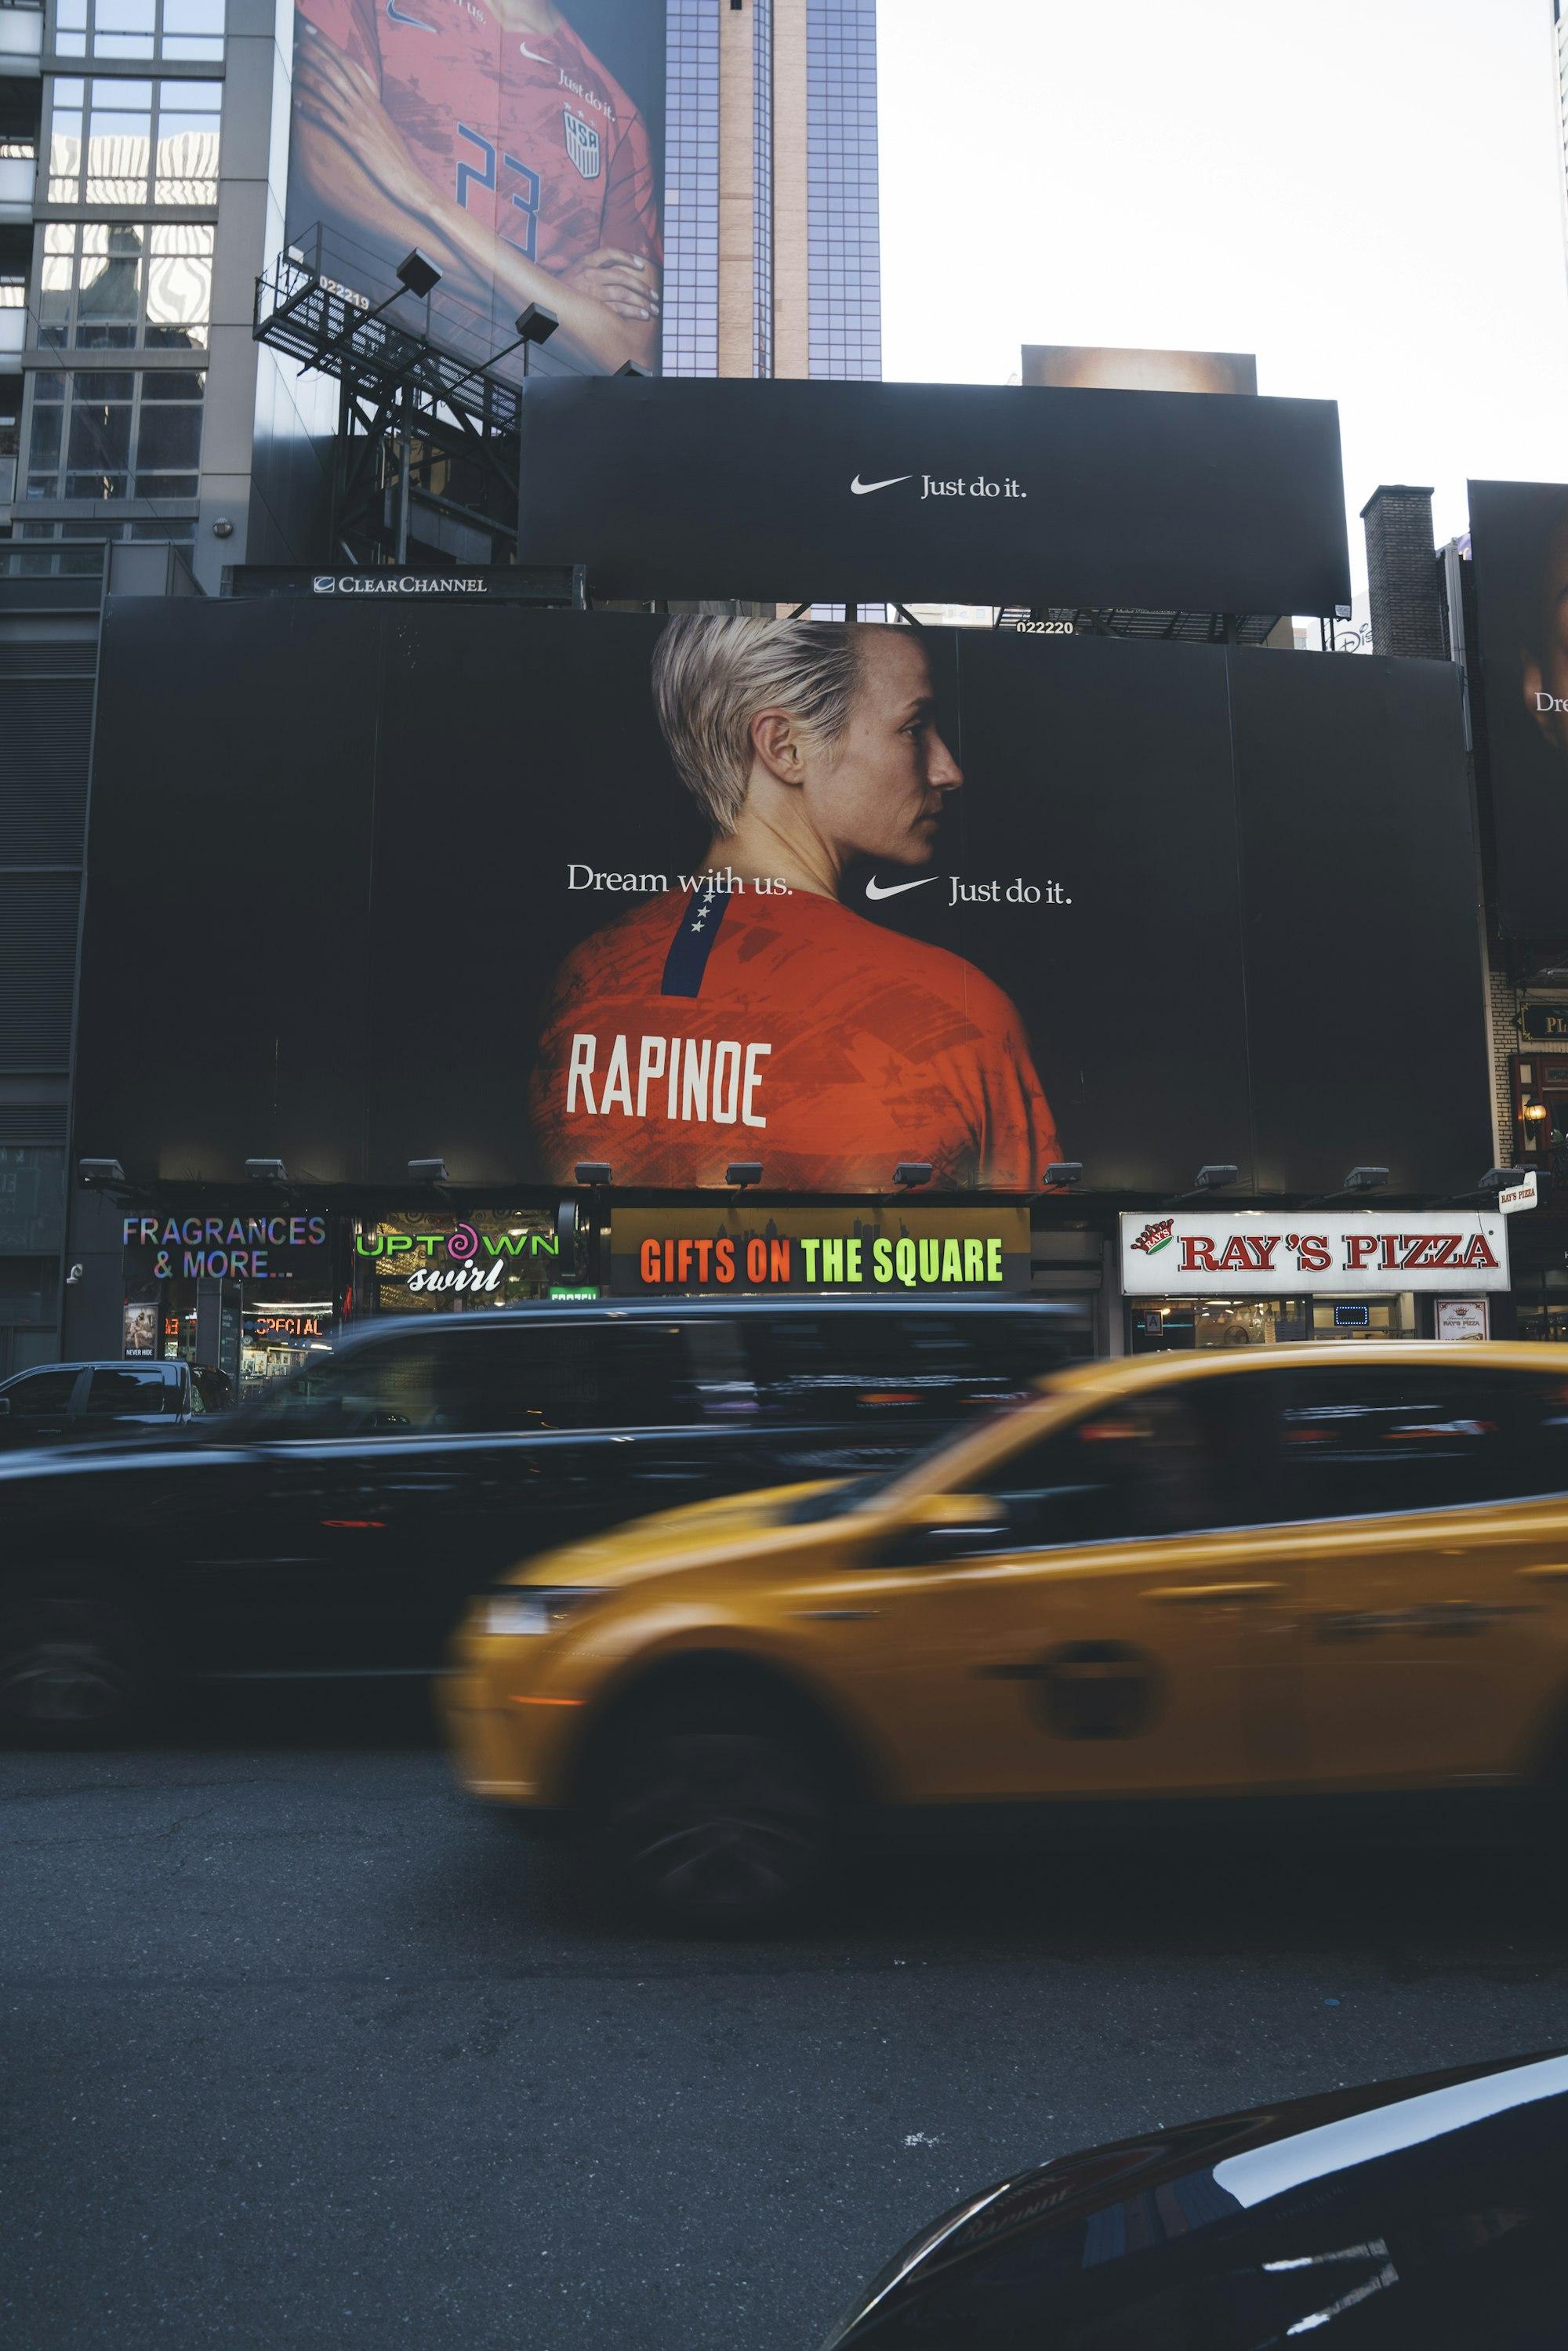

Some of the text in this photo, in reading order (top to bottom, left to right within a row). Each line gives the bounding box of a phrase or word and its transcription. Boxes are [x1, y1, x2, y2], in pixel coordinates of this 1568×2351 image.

[558, 68, 617, 122] Just do it.
[566, 115, 597, 149] USA
[456, 122, 541, 263] 23
[319, 276, 370, 310] 022219
[921, 475, 1027, 499] Just do it.
[1017, 622, 1073, 633] 022220
[567, 865, 793, 895] Dream with us.
[949, 876, 1073, 906] Just do it.
[566, 1033, 771, 1128] RAPINOE
[1501, 1188, 1535, 1203] RAY'S PIZZA
[122, 1217, 326, 1246] FRAGRANCES
[357, 1223, 559, 1260] UPTOWN
[1145, 1228, 1170, 1249] RAY'S
[154, 1250, 173, 1279] &
[641, 1238, 1004, 1287] GIFTS ON THE SQUARE
[1178, 1233, 1501, 1272] RAY'S PIZZA
[407, 1258, 504, 1292] swirl
[256, 1318, 322, 1335] SPECIAL
[1149, 1318, 1158, 1326] A
